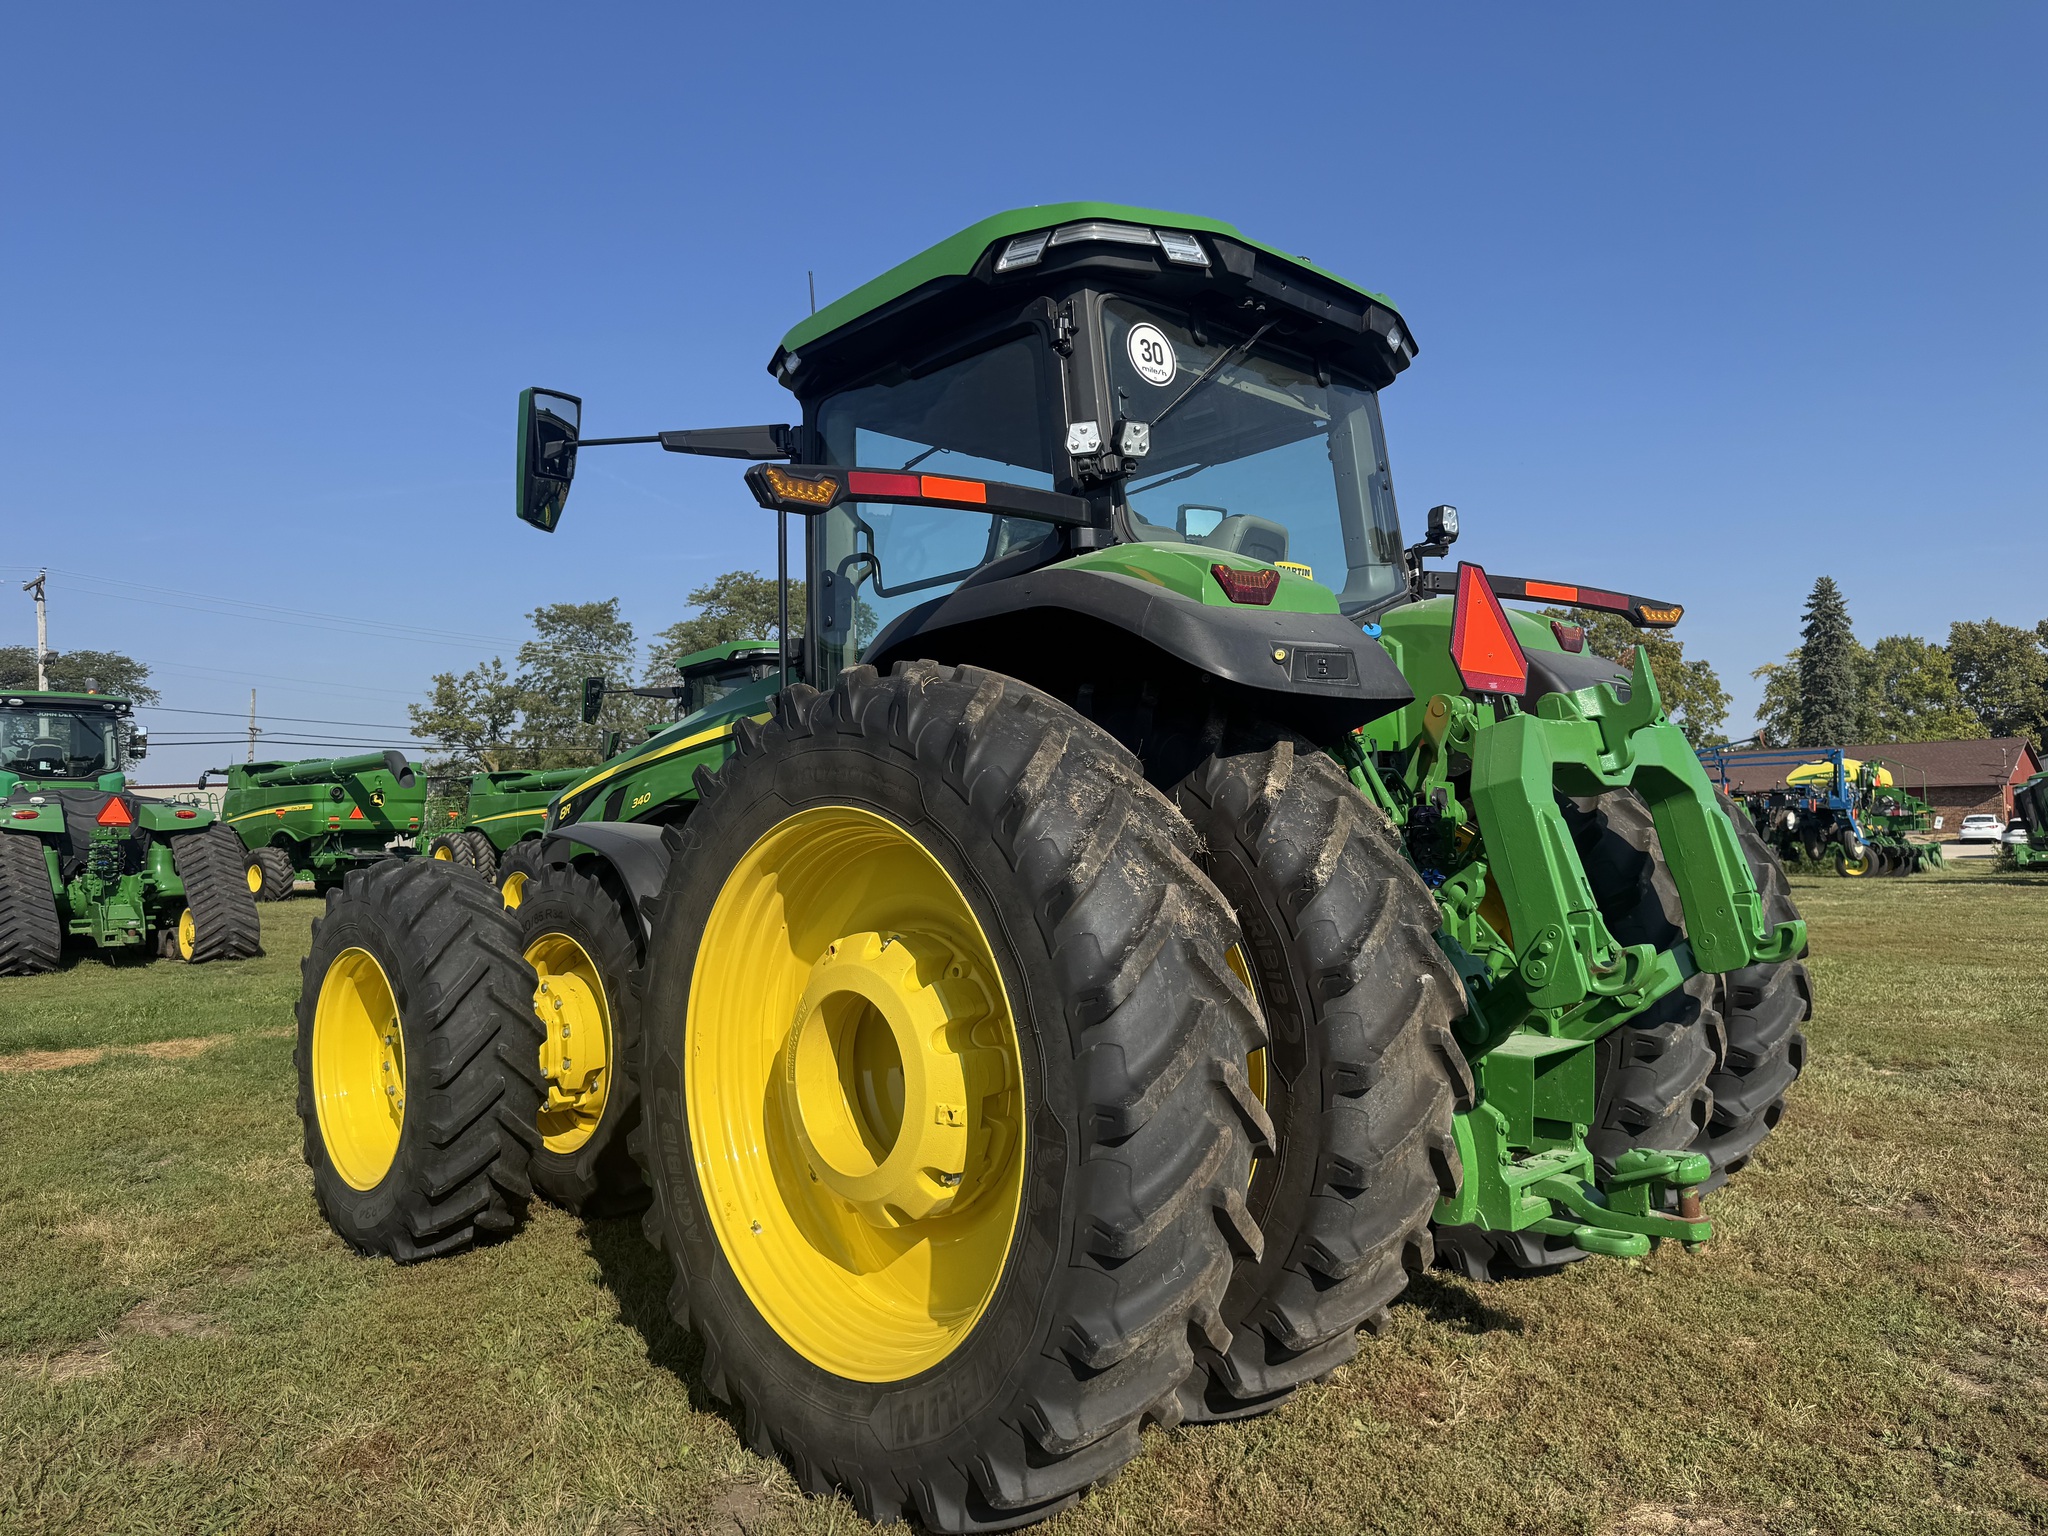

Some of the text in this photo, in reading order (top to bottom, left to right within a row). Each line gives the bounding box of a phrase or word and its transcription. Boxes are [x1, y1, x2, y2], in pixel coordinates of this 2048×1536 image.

[1140, 338, 1164, 366] 30
[559, 803, 572, 820] 8R
[631, 792, 651, 809] 340
[1227, 882, 1301, 1044] AGRIBIB 2
[656, 1086, 703, 1242] AGRIBIB 2
